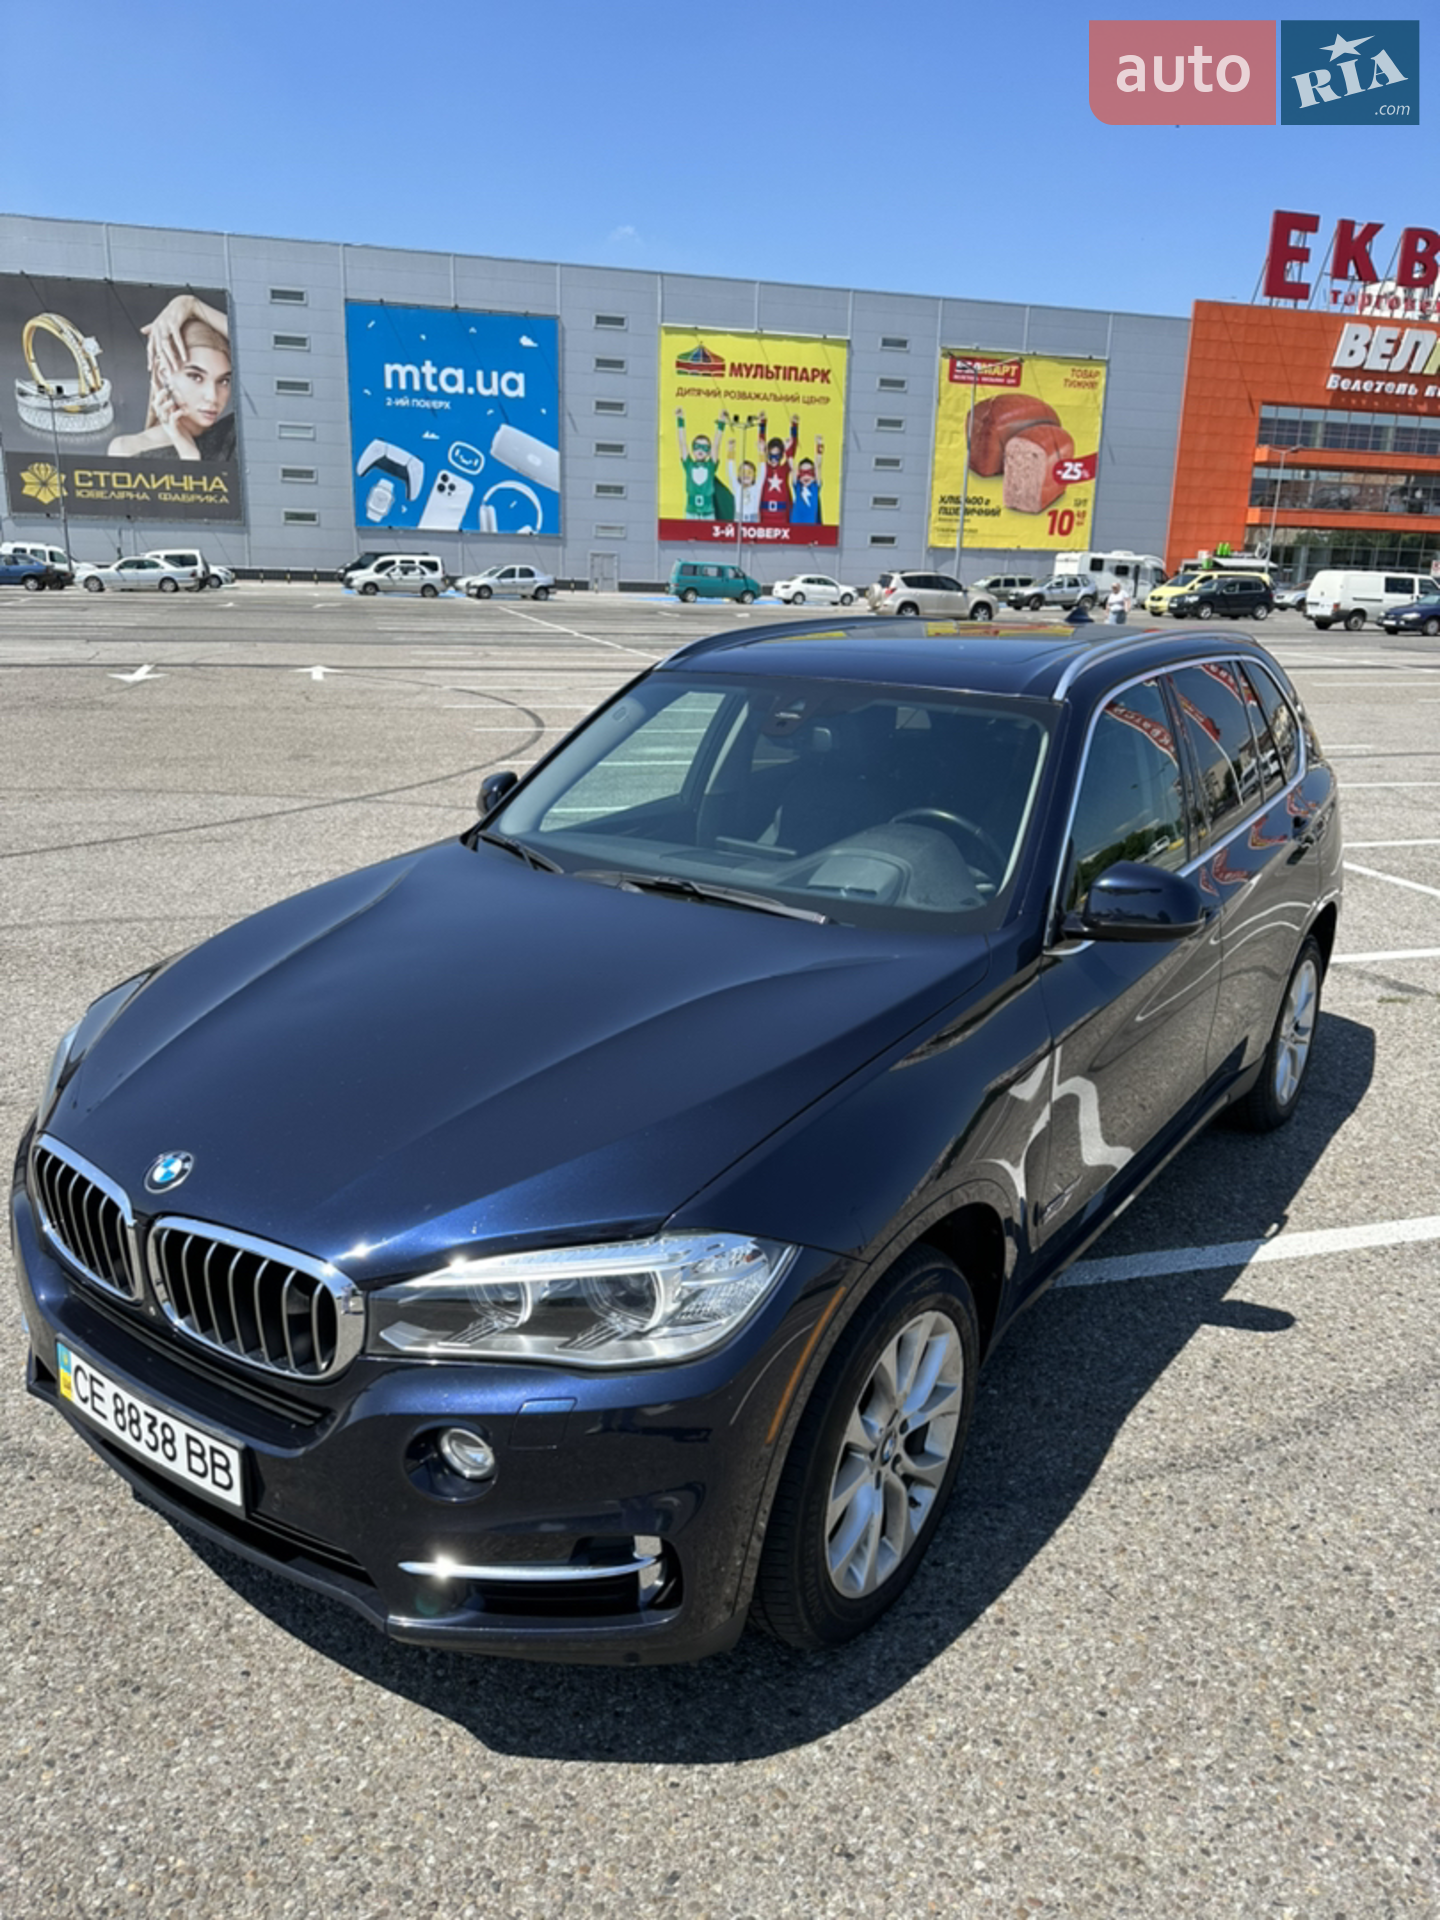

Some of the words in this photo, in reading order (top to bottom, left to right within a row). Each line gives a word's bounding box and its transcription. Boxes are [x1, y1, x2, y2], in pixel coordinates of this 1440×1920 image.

[1330, 289, 1440, 315] торгове
[384, 359, 525, 398] mta.ua
[729, 362, 832, 384] МУЛЬТІПАРК
[74, 469, 228, 494] СТОЛИЧНА
[76, 488, 150, 502] ЮВЕЛІРНА
[158, 491, 229, 504] ФАБРИКА
[712, 523, 735, 538] 3-Й
[1048, 509, 1075, 538] 10
[74, 1364, 108, 1421] CE
[112, 1391, 177, 1462] 8838
[185, 1432, 233, 1491] BB
